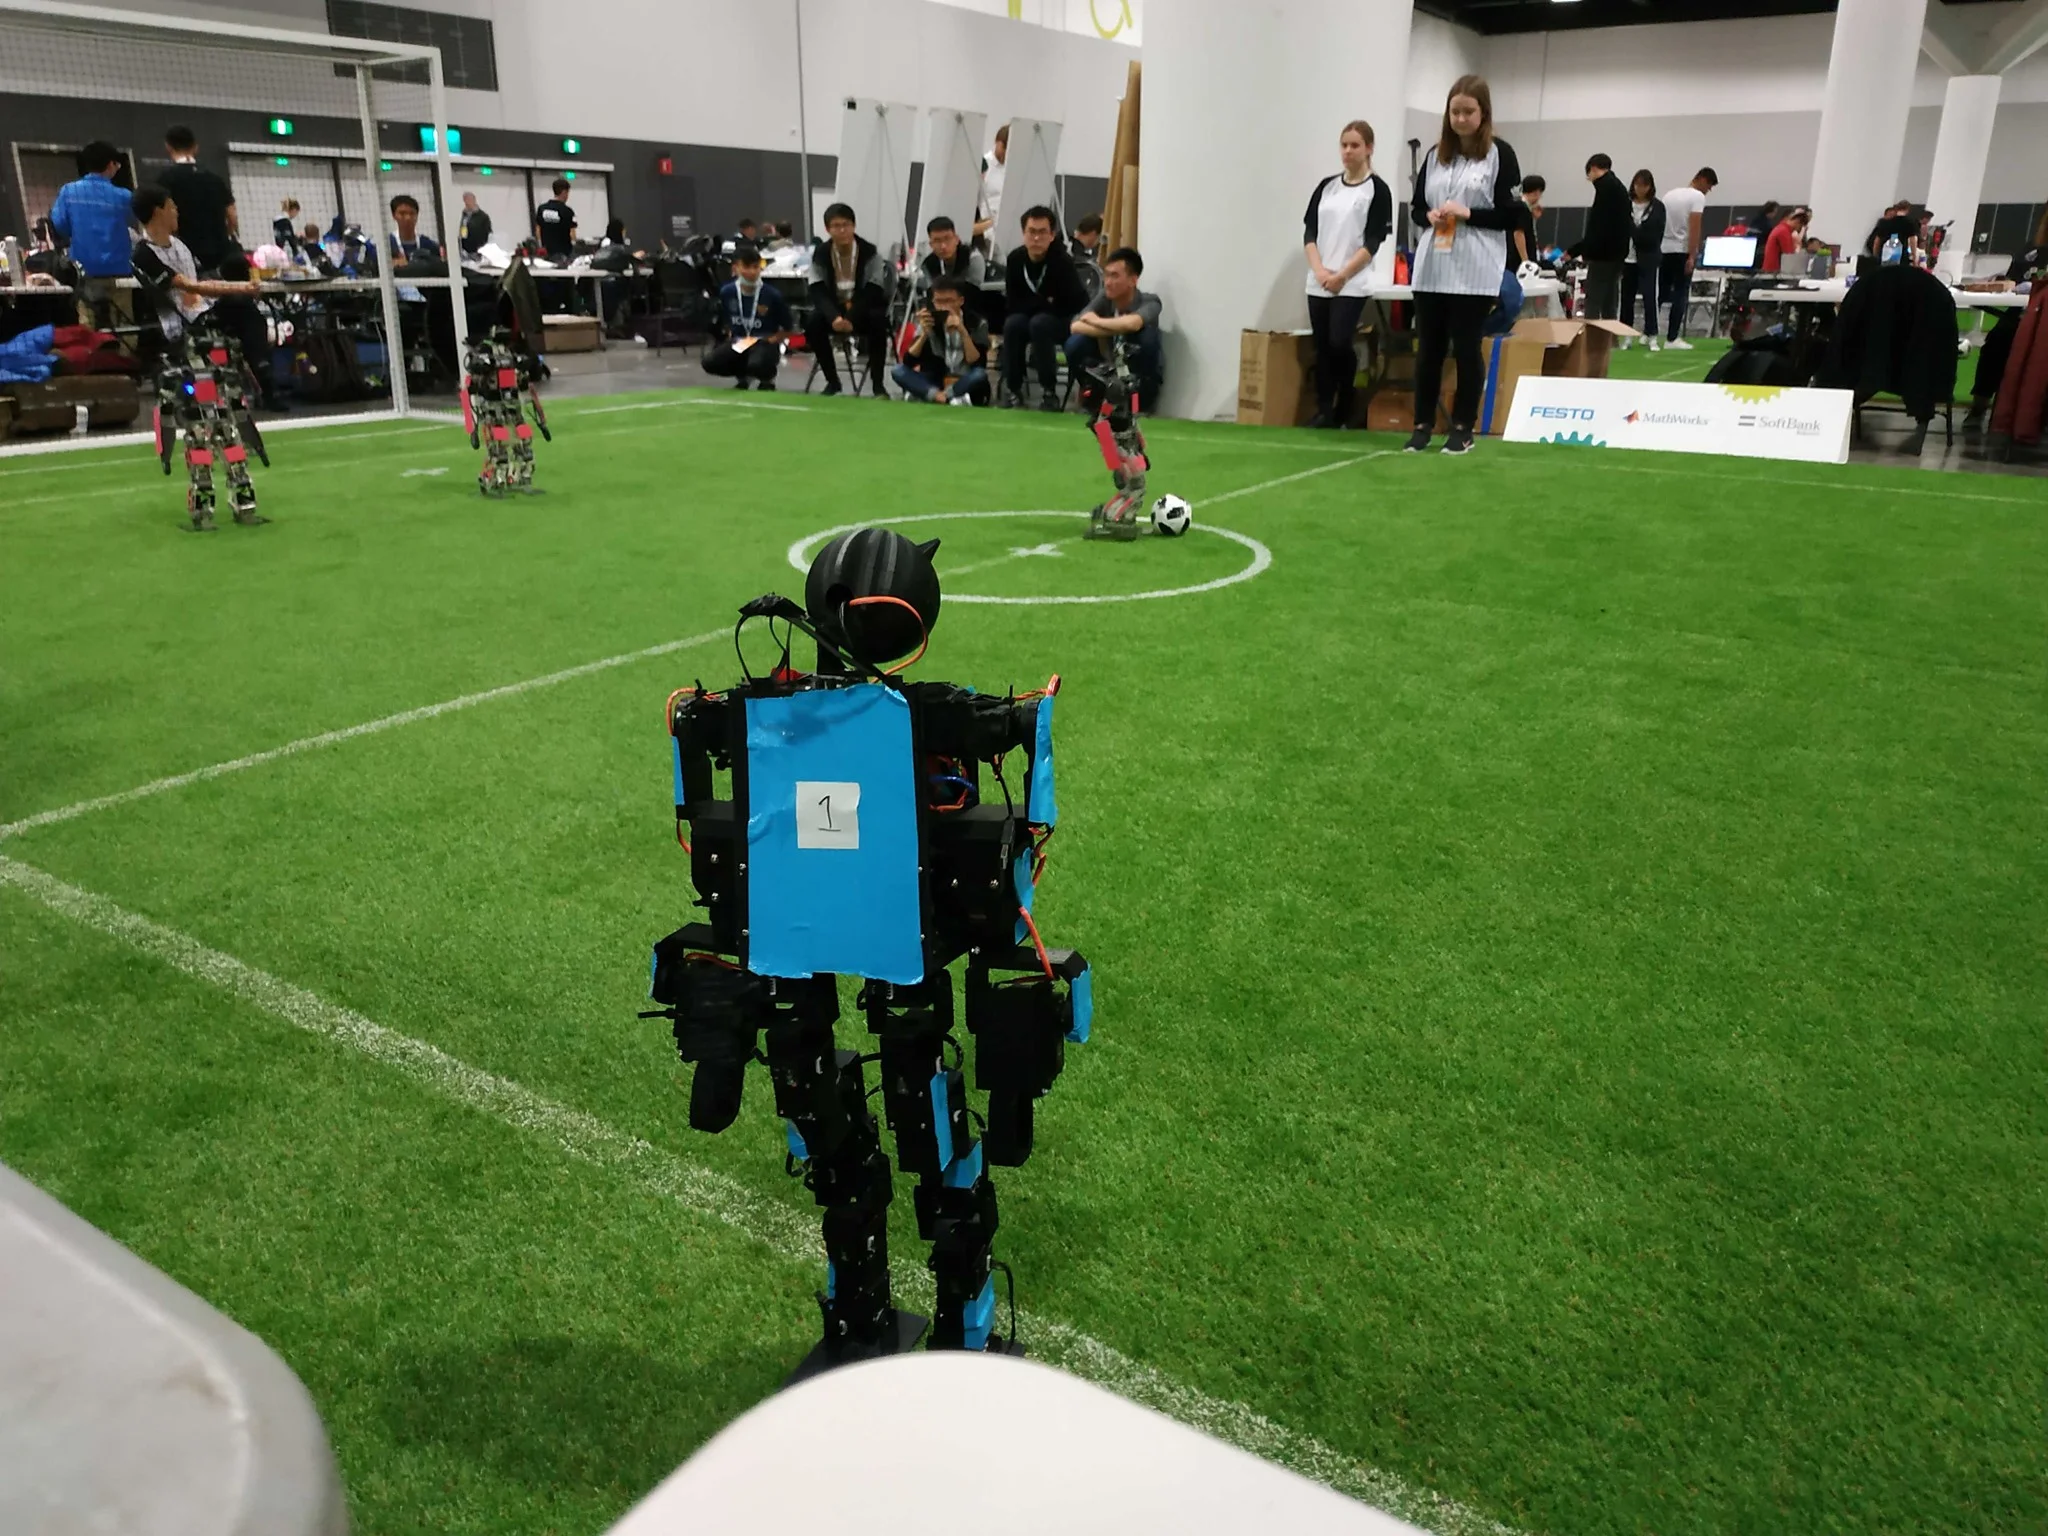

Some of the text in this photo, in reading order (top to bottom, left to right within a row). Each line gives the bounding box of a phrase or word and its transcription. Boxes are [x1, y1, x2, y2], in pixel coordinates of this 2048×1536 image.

[1530, 406, 1595, 421] FESTO
[1642, 412, 1709, 426] MathWorks
[1759, 416, 1821, 432] SoftBank
[818, 795, 842, 832] 1
